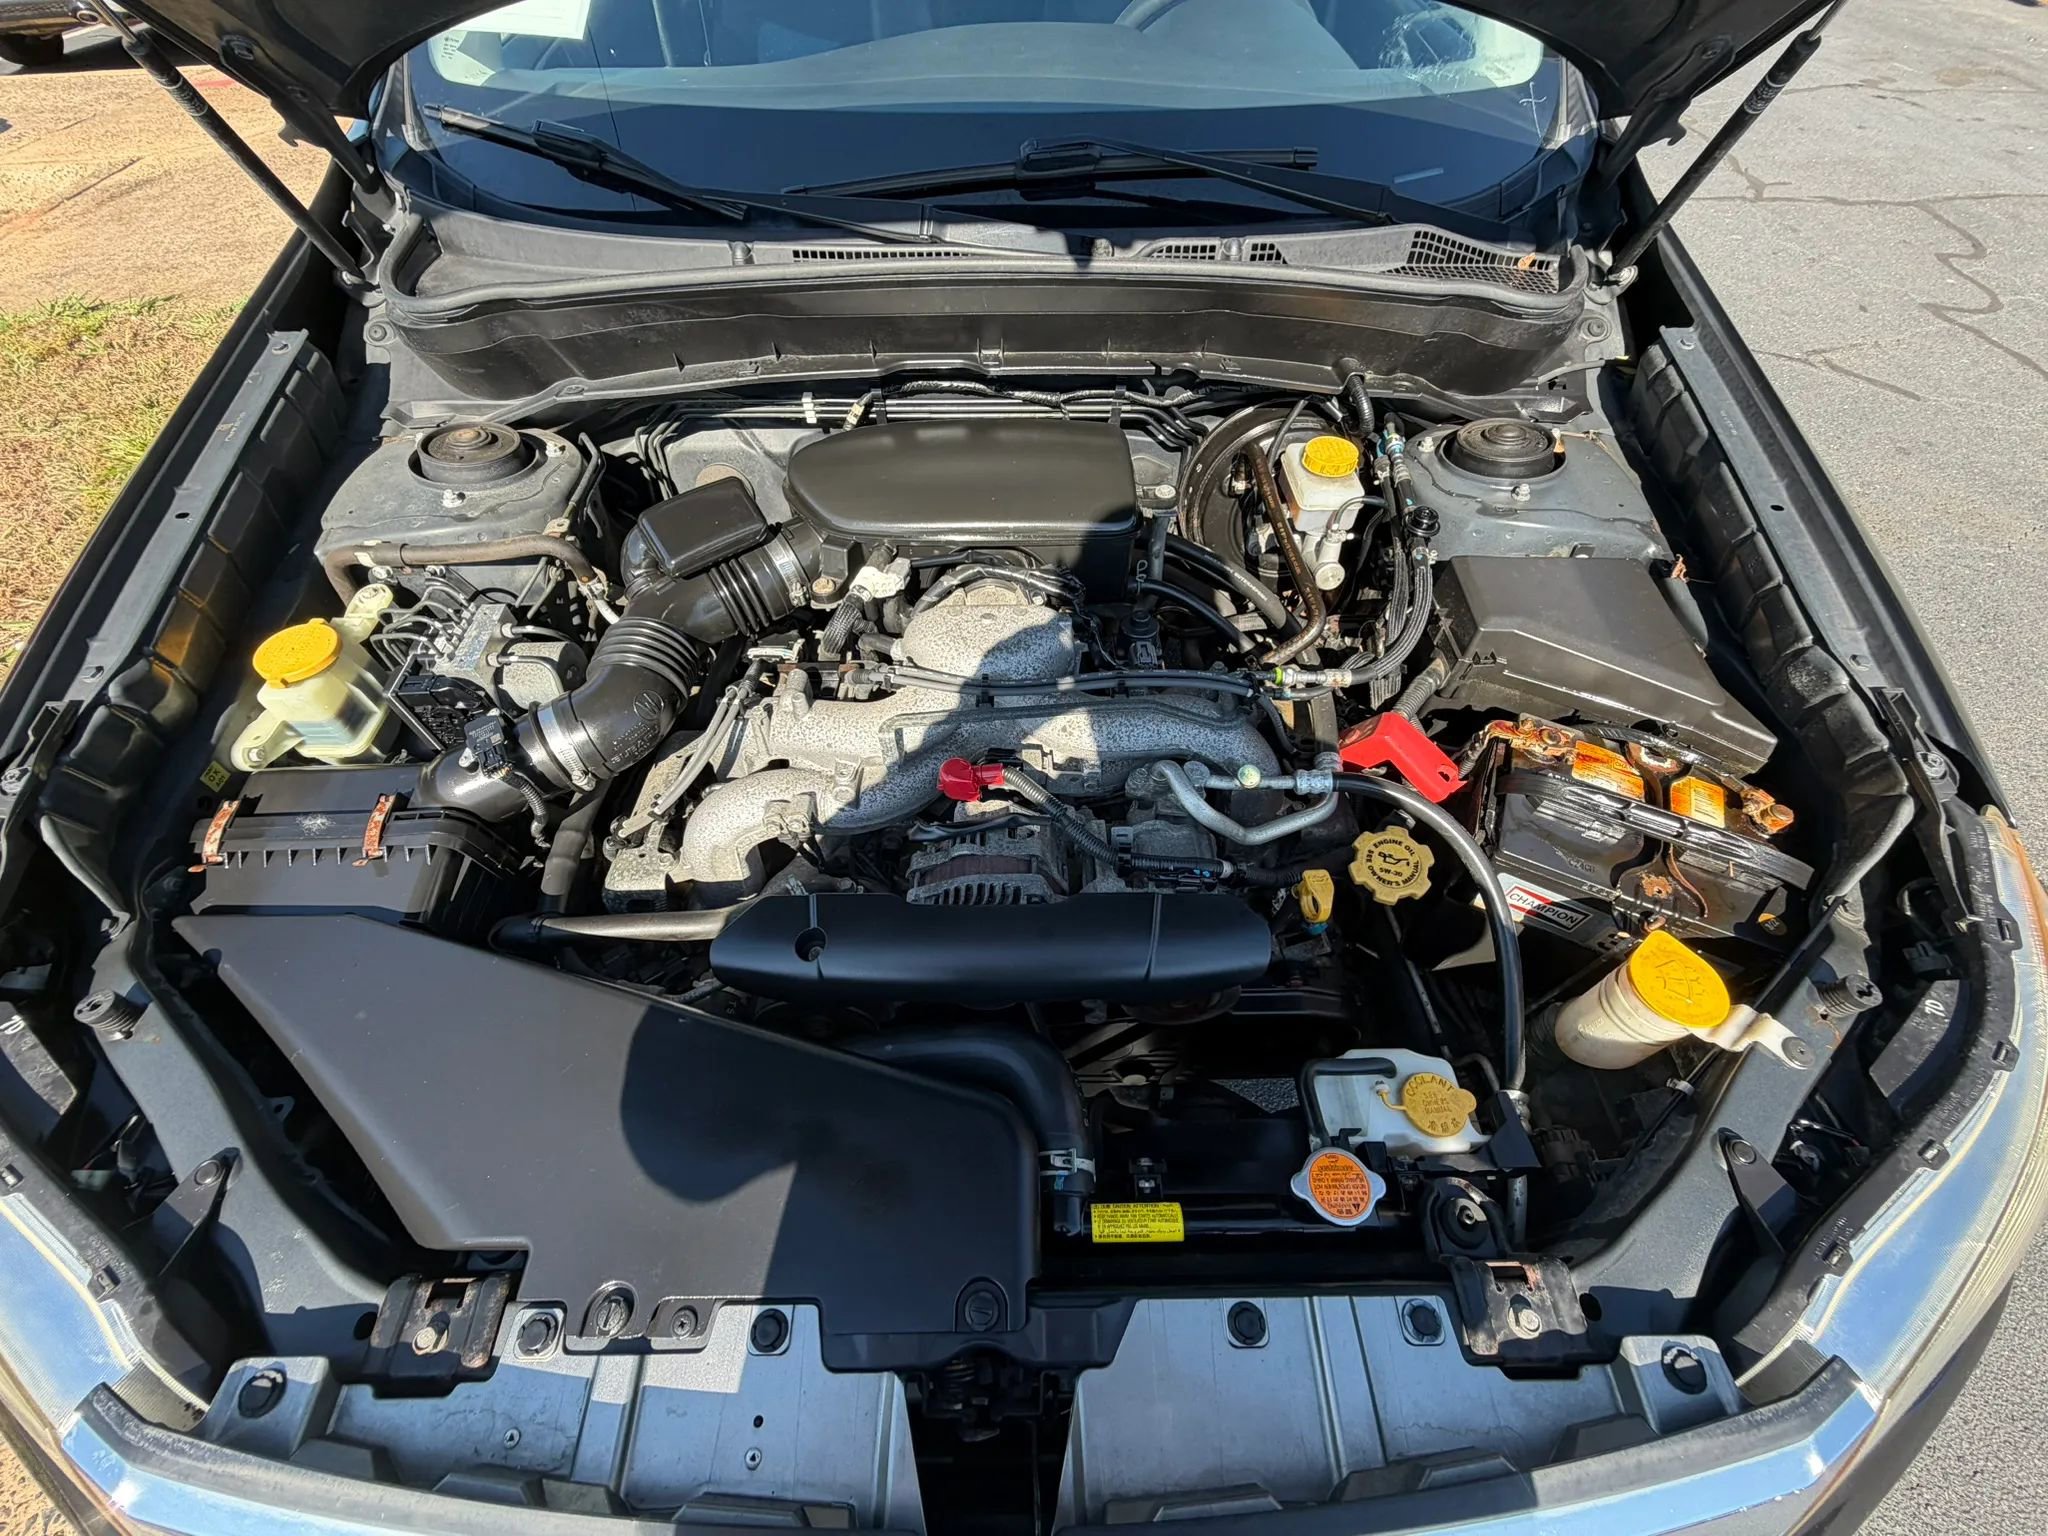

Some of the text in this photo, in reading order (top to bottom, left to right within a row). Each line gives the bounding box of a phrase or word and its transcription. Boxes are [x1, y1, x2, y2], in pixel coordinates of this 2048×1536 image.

[1373, 838, 1416, 857] ENGINE OIL
[1366, 849, 1419, 886] SEE OWNER'S MANUAL
[1379, 867, 1403, 877] 5W-30
[1509, 892, 1579, 925] CHAMPION
[1405, 1075, 1456, 1097] COOLANT
